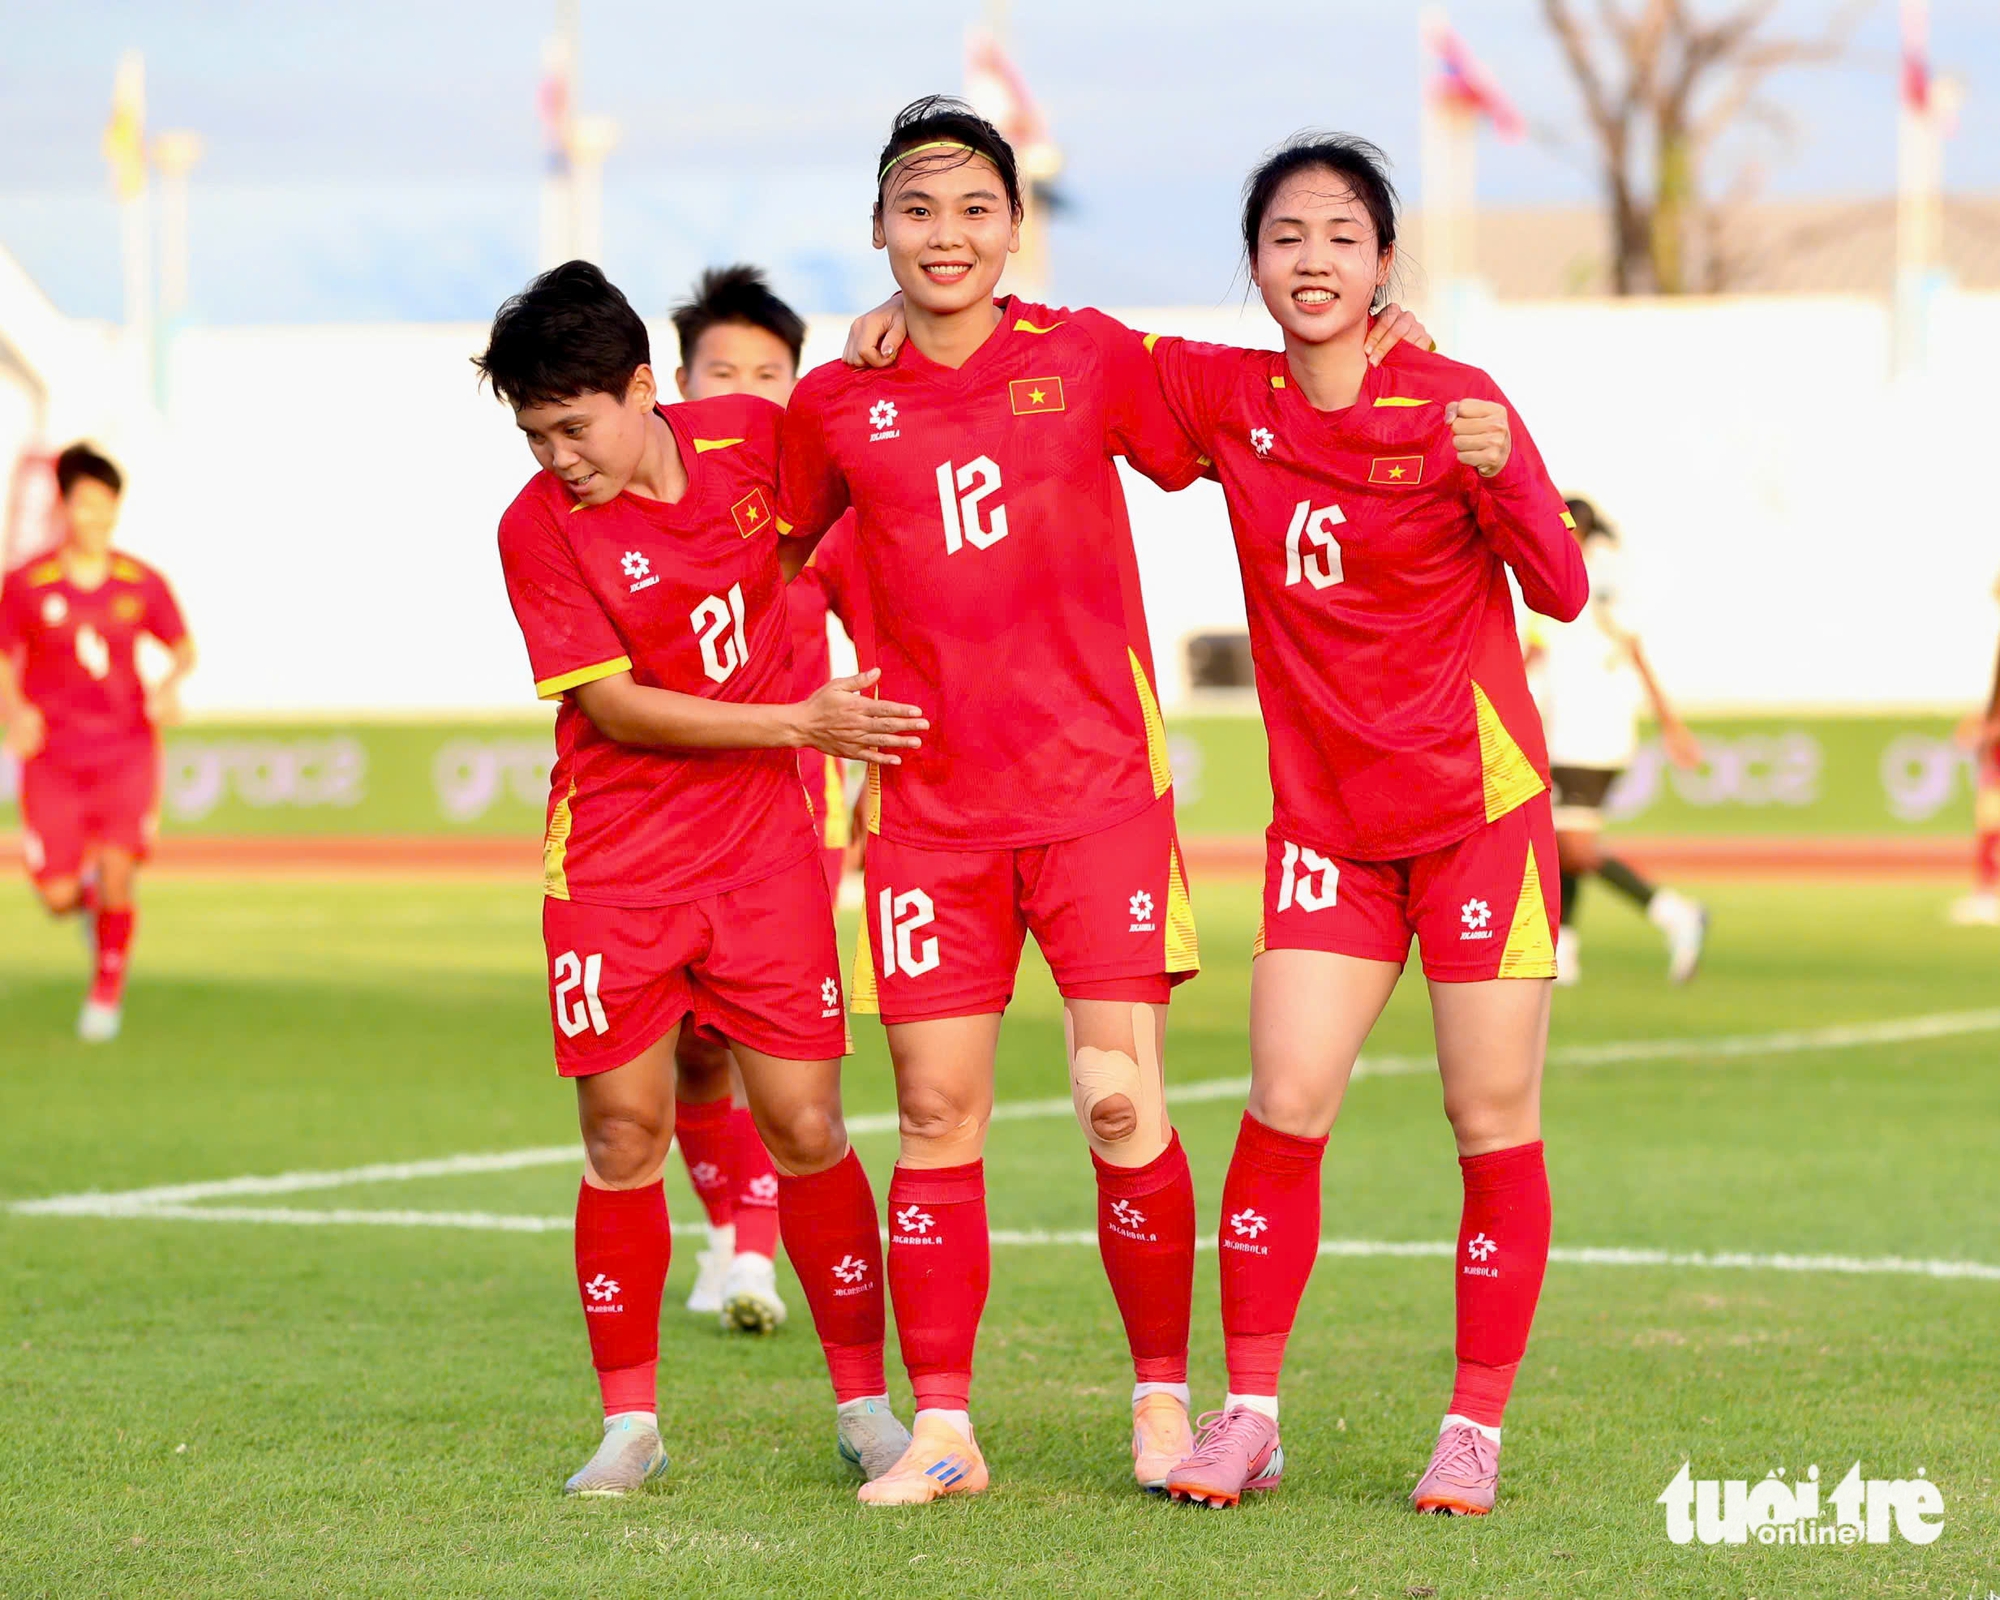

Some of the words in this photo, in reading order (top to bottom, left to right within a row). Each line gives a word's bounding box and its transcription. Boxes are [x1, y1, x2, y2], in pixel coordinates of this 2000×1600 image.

[936, 455, 1009, 555] 12
[1285, 500, 1347, 590] 15
[689, 581, 749, 684] 21
[165, 737, 367, 822] grace
[1277, 841, 1341, 913] 15
[878, 886, 940, 980] 12
[554, 950, 610, 1039] 21
